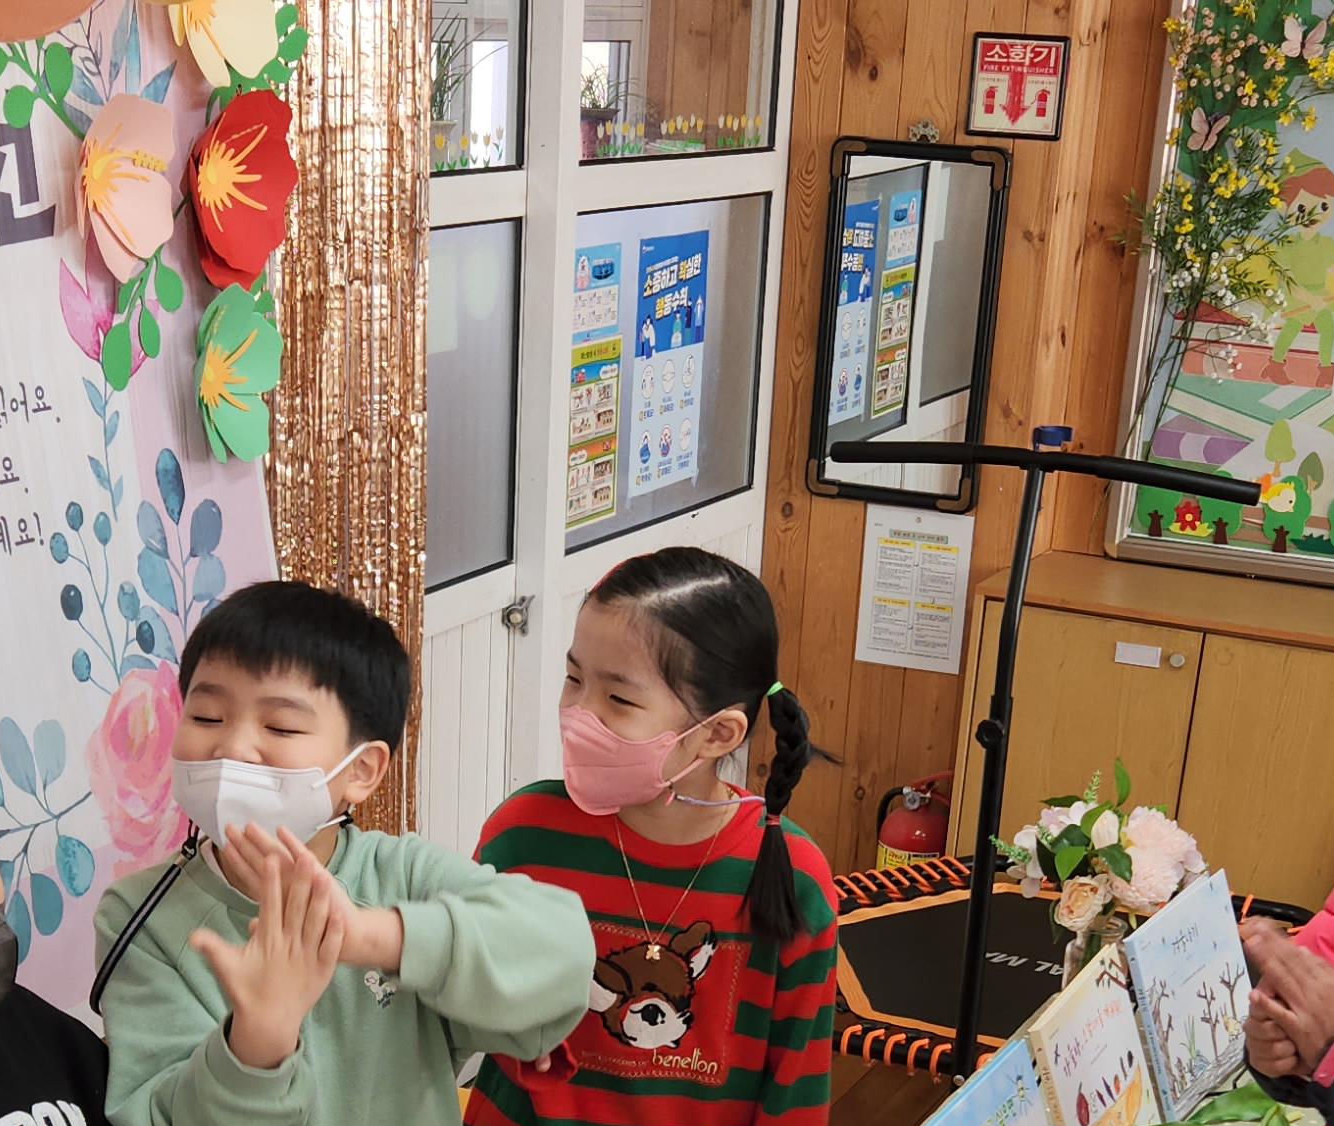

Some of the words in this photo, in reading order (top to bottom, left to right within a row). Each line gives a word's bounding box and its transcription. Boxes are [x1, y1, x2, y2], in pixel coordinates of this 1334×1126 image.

[983, 64, 999, 72] FIRE
[1001, 65, 1054, 74] EXTINGUISHER
[984, 44, 1056, 68] 소화기
[643, 264, 680, 298] 소중하고
[679, 252, 702, 281] 확실한
[655, 286, 689, 320] 행동수칙
[652, 1047, 718, 1076] benetton
